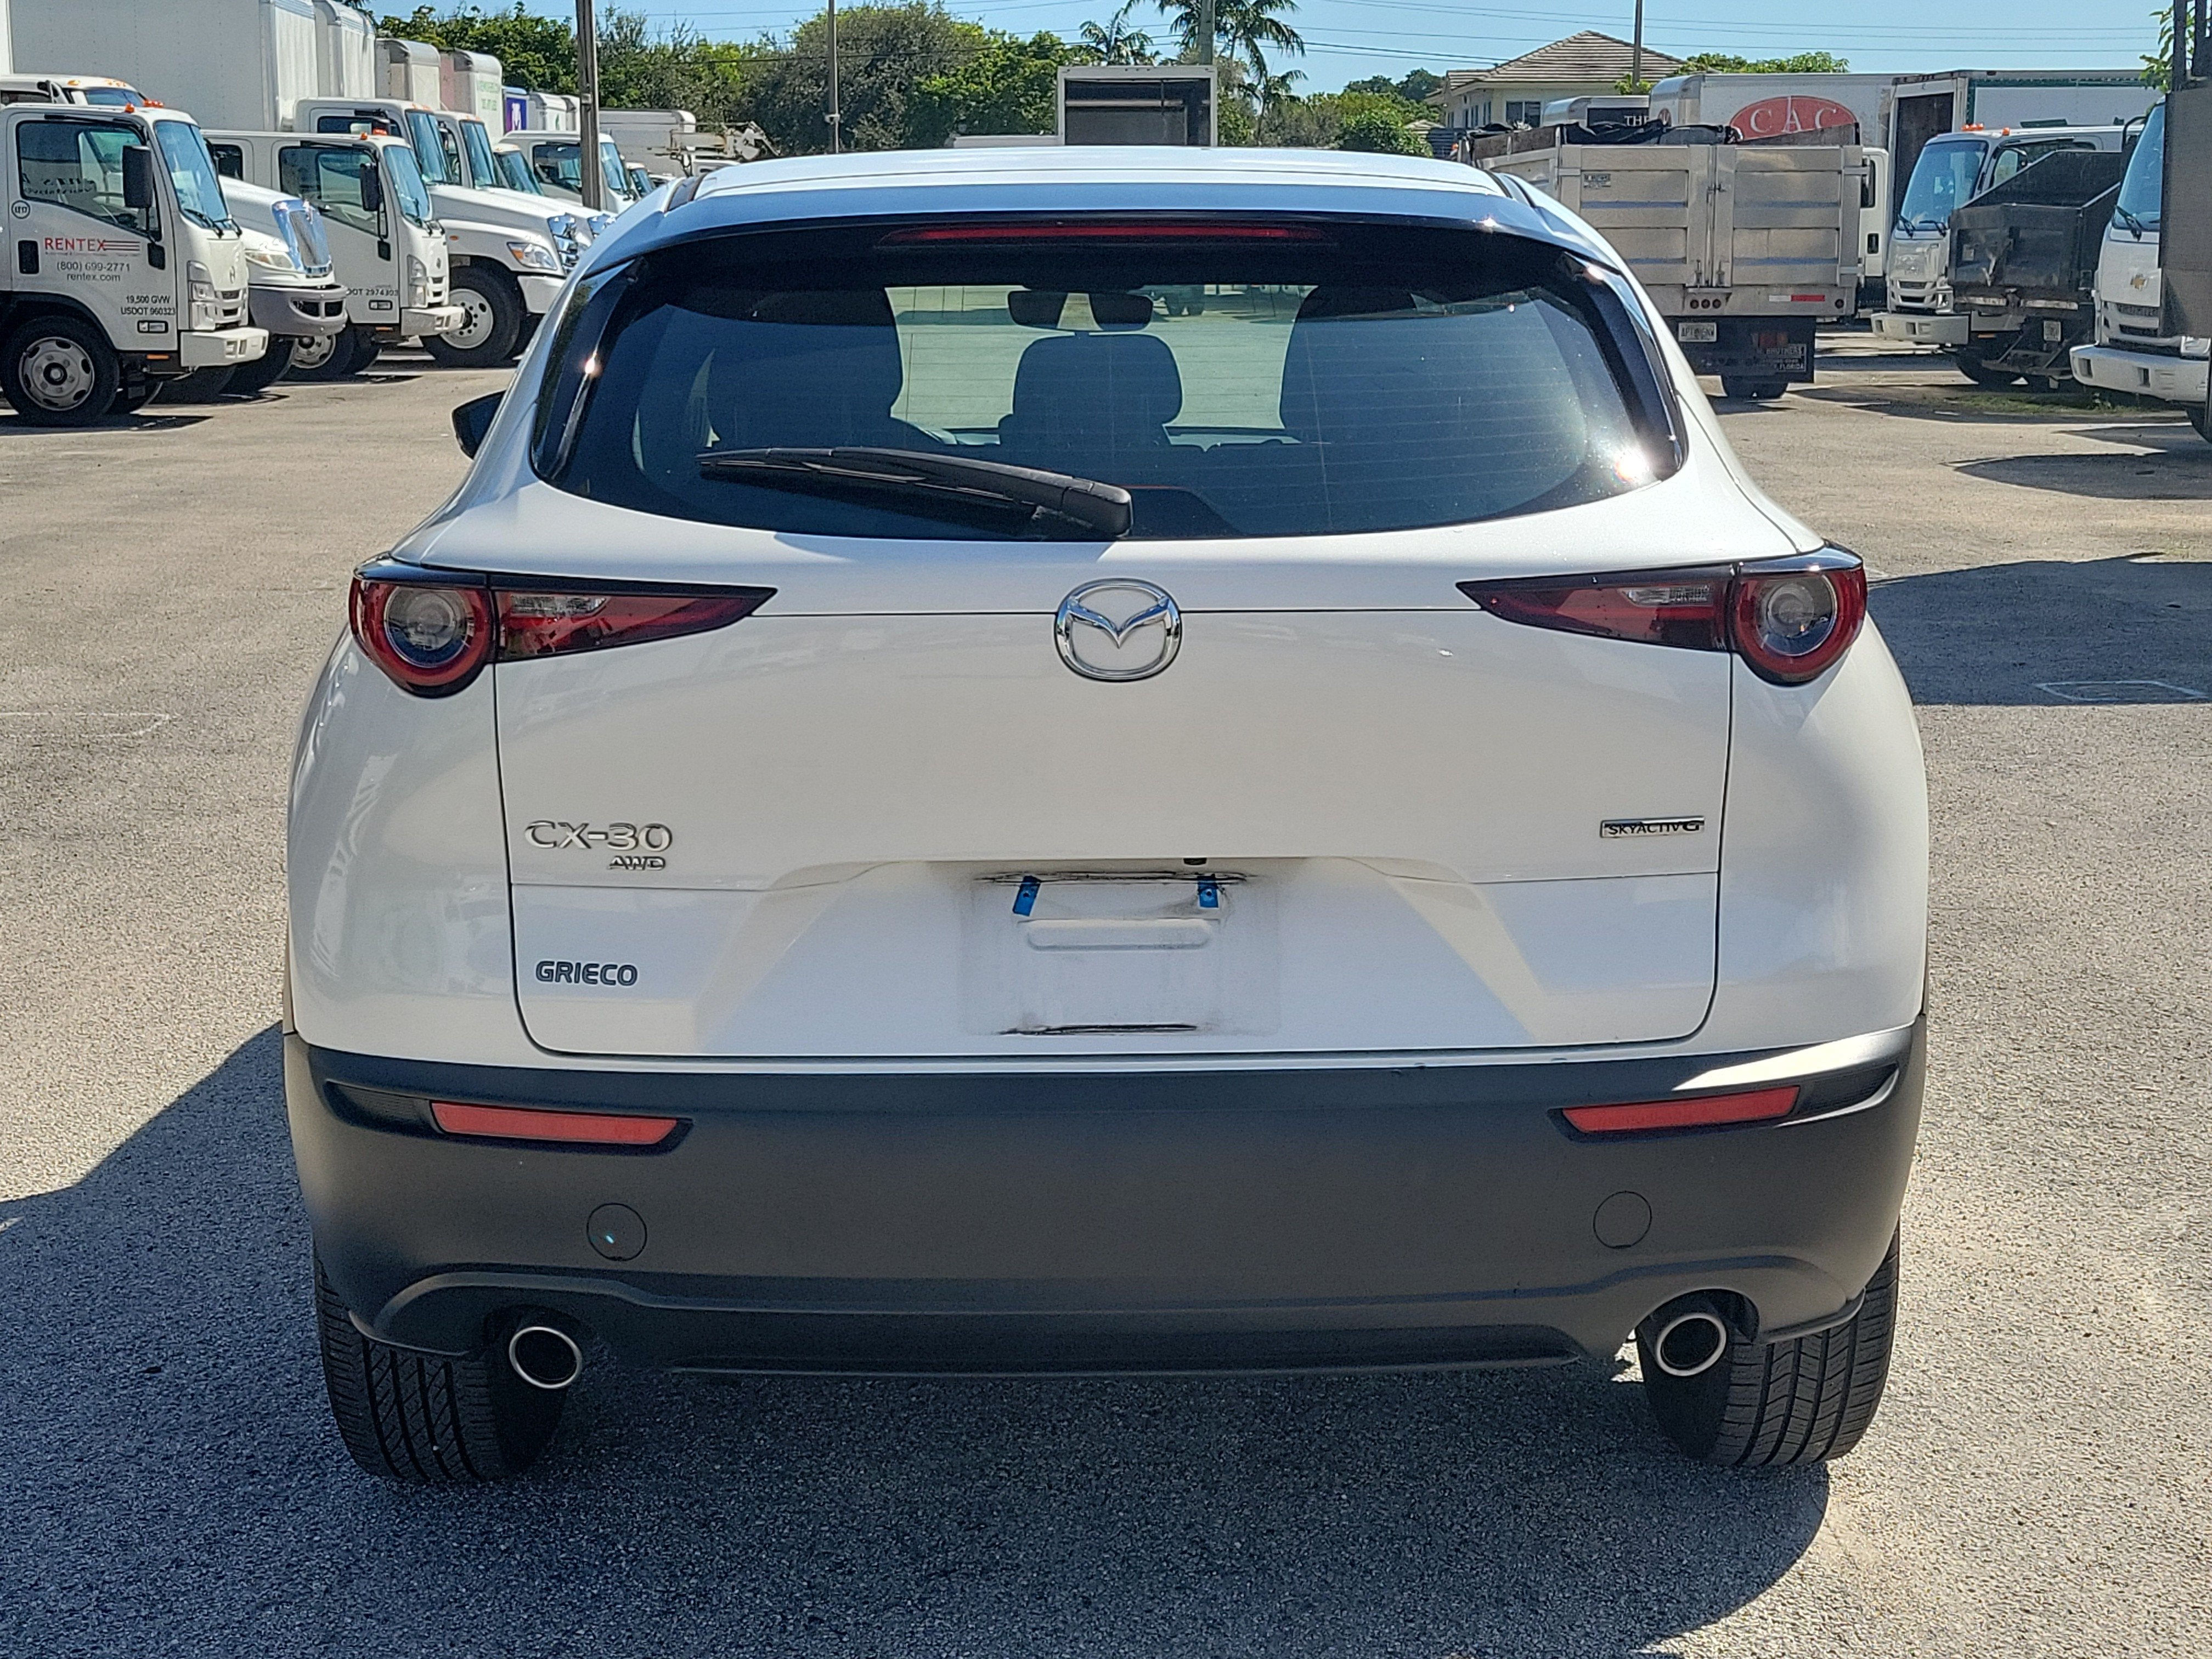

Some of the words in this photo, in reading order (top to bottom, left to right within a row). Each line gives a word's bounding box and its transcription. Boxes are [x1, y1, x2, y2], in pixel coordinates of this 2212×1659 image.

[44, 237, 105, 251] RENTEX
[57, 261, 82, 272] (800)
[85, 262, 131, 272] 699-2771
[66, 273, 121, 282] rentex.com
[151, 295, 171, 303] GVW
[121, 306, 148, 315] USDOT
[524, 820, 673, 852] CX-30
[608, 855, 666, 871] AWD
[535, 960, 638, 986] GRIECO
